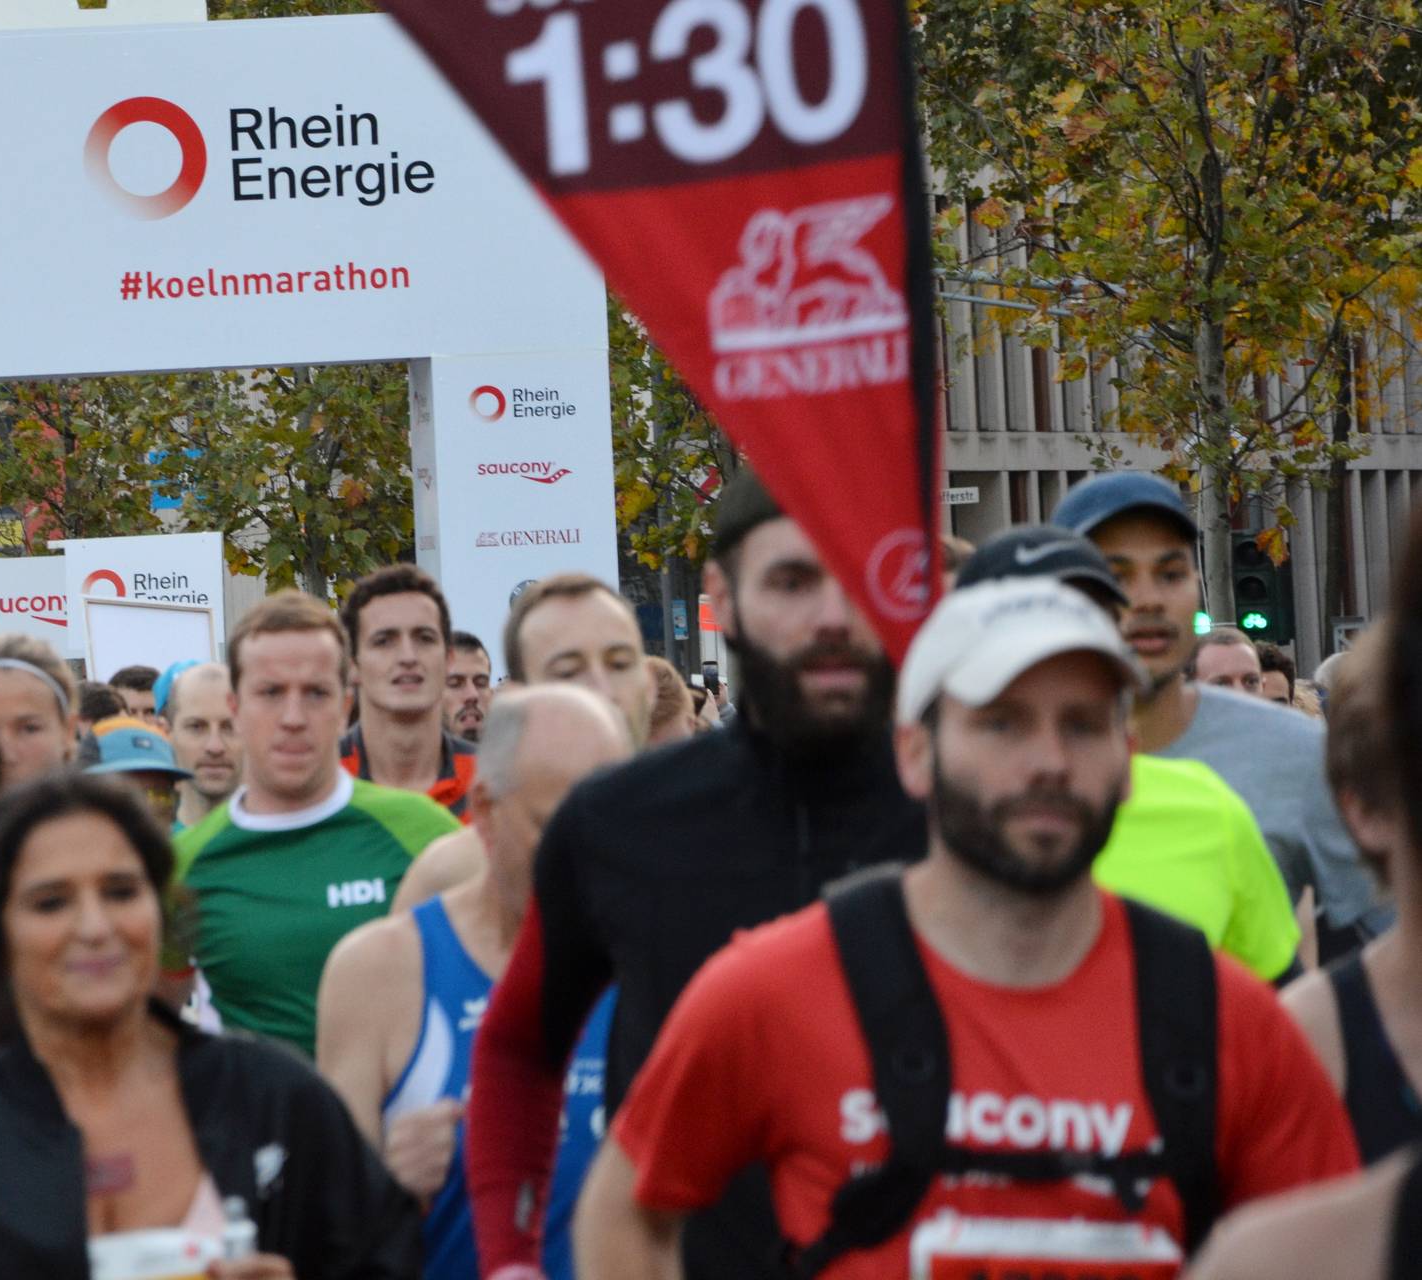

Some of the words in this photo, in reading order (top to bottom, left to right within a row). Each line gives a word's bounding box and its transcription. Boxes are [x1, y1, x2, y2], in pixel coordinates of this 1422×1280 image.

[504, 0, 869, 177] 1:30
[229, 103, 379, 151] Rhein
[232, 151, 435, 207] Energie
[120, 262, 410, 300] #koelnmarathon
[512, 388, 559, 402] Rhein
[513, 401, 576, 419] Energie
[478, 462, 551, 476] saucony
[501, 529, 581, 547] GENERALI
[133, 572, 189, 590] Rhein
[327, 878, 386, 908] HDI
